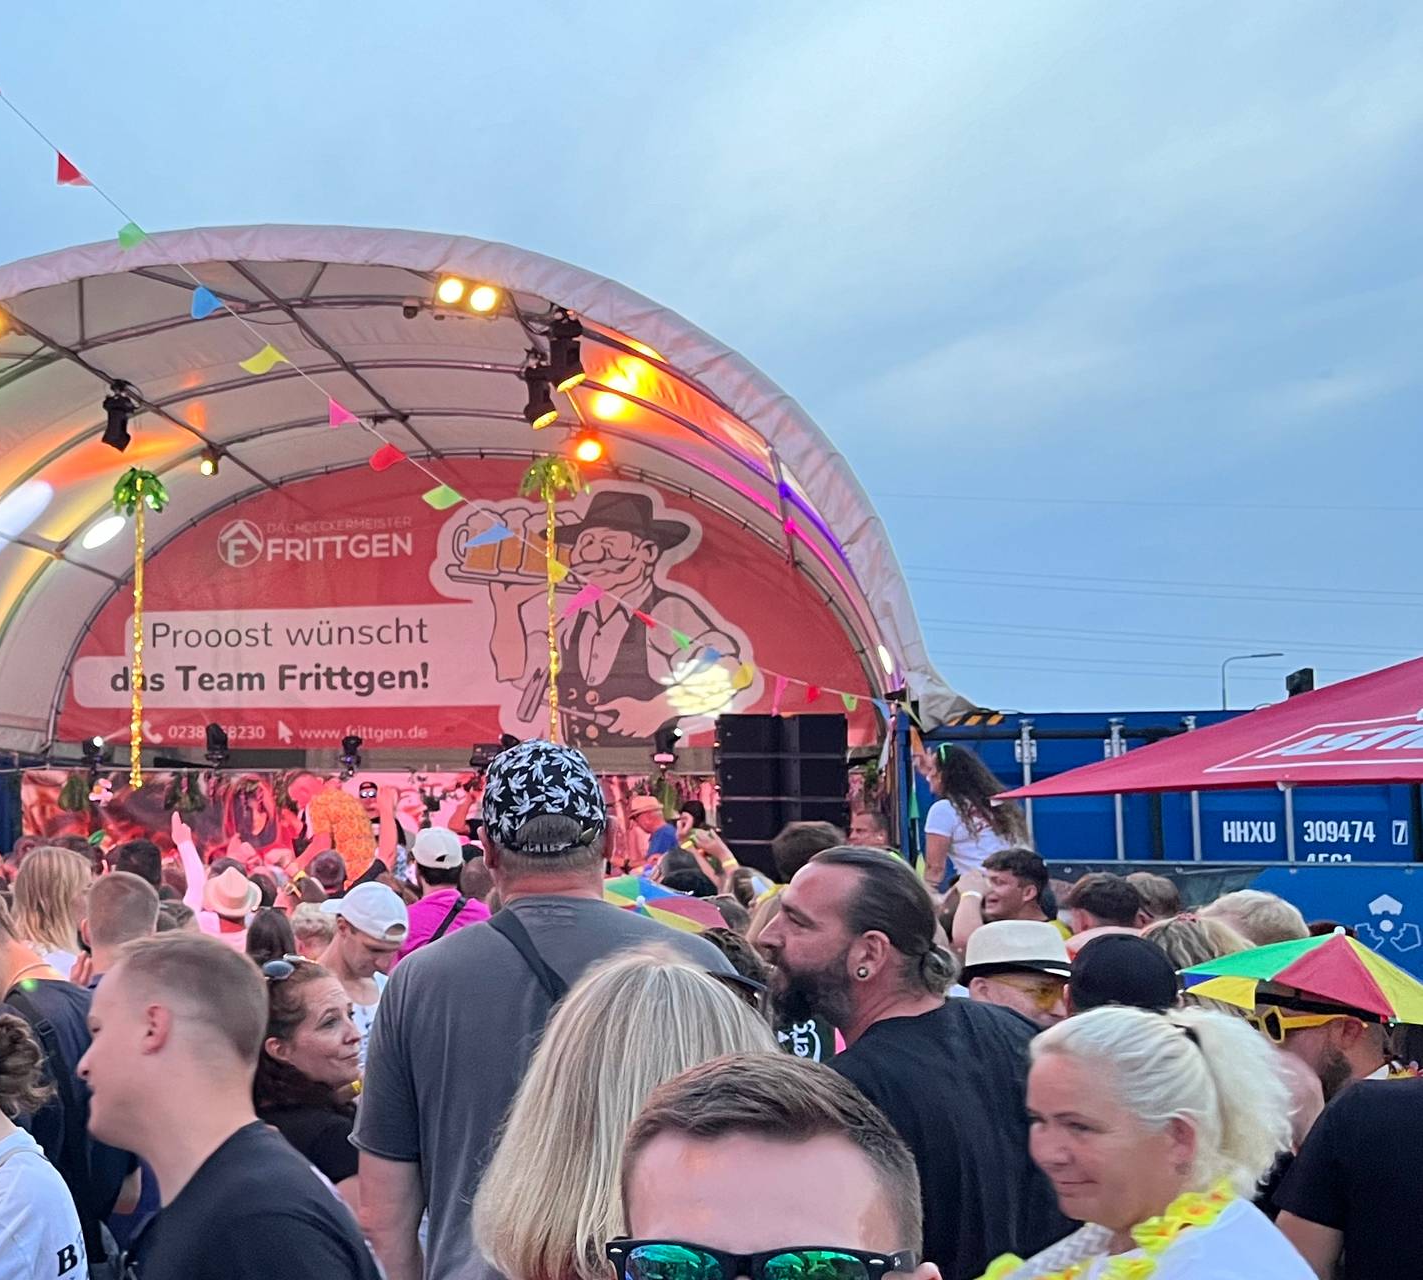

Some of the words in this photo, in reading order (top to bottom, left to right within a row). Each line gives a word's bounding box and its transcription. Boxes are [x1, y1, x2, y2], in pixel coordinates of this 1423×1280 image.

[267, 532, 413, 562] FRITTGEN
[151, 621, 273, 649] Prooost
[285, 617, 429, 647] wünscht
[175, 665, 265, 692] Team
[278, 662, 430, 697] Frittgen!
[1222, 820, 1276, 843] HHXU
[1303, 820, 1376, 843] 309474
[1394, 821, 1407, 844] 7
